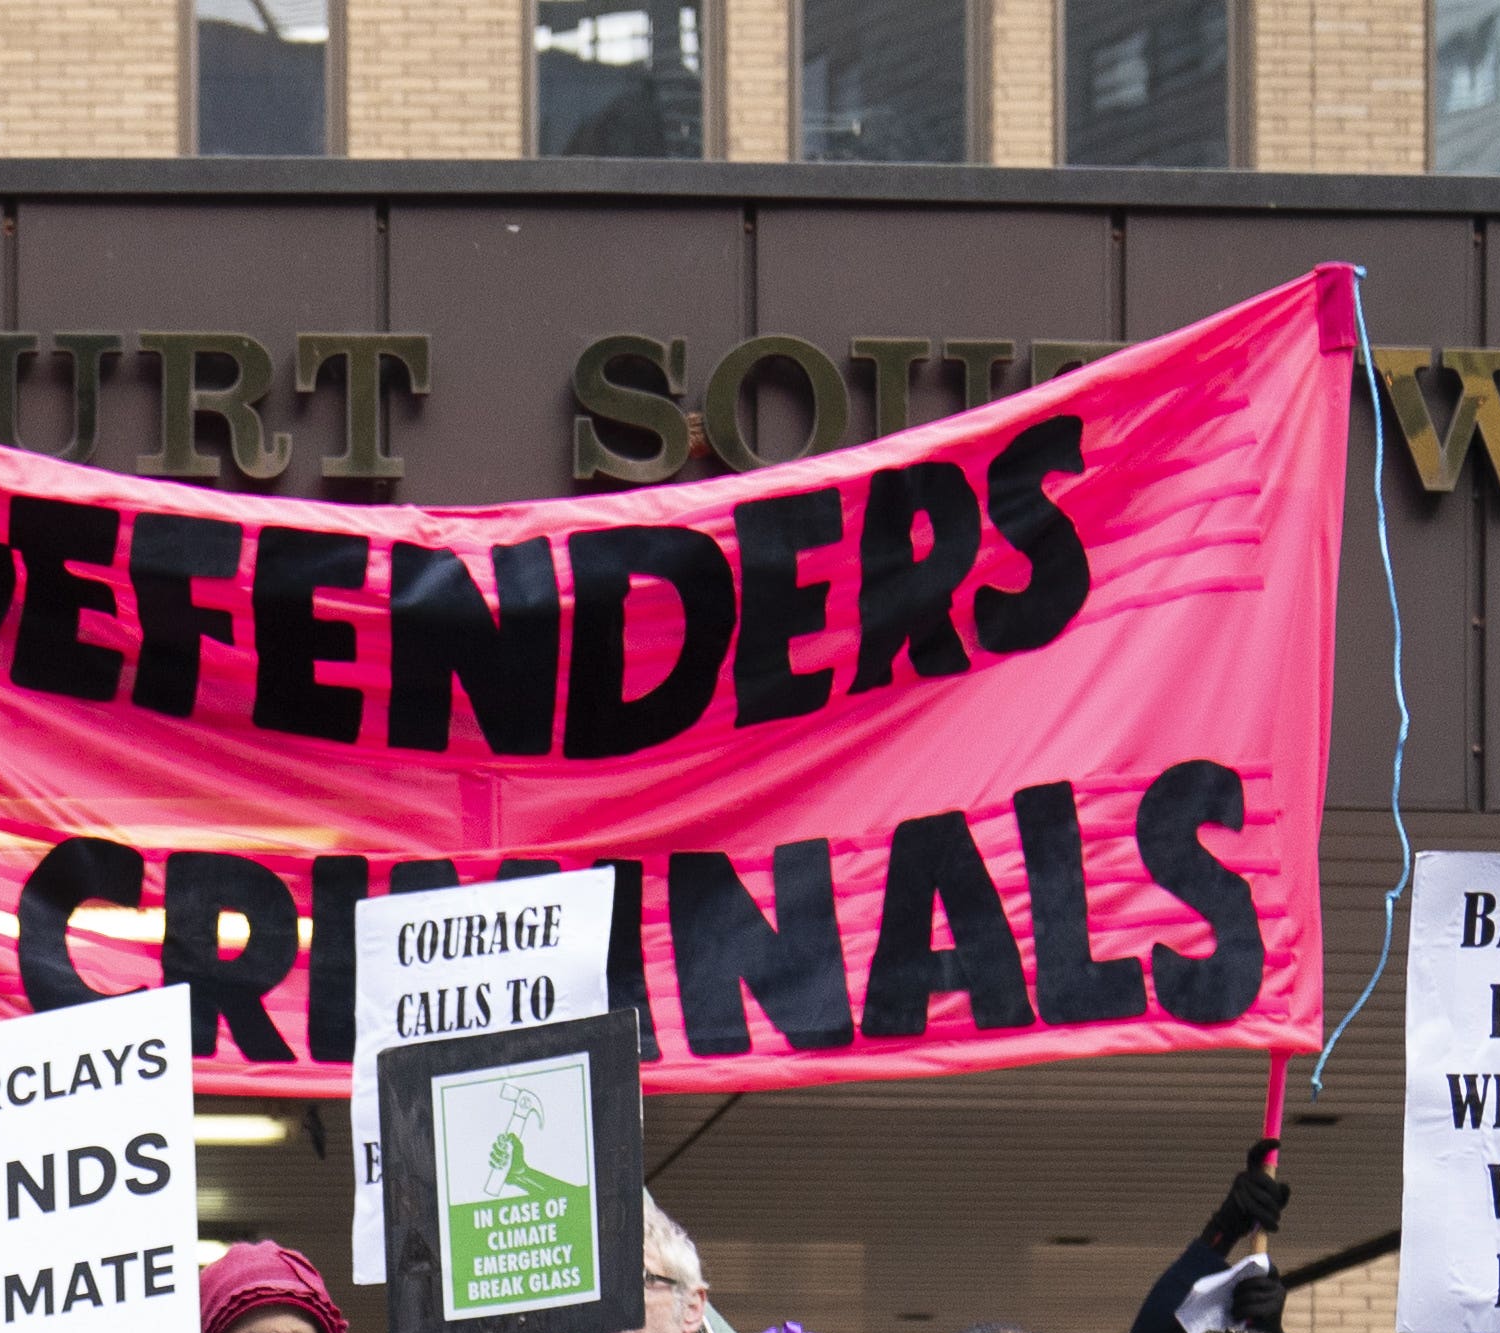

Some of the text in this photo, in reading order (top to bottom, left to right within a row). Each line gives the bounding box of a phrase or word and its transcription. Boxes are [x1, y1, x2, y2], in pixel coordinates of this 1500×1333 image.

[17, 760, 1266, 1063] CRIINALS
[397, 903, 562, 967] COURAGE
[396, 975, 556, 1039] CALLS TO
[473, 1197, 568, 1229] IN CASE OF
[487, 1223, 557, 1251] CLIMATE
[473, 1244, 573, 1277] EMERGENCY
[467, 1266, 581, 1301] BREAK GLASS
